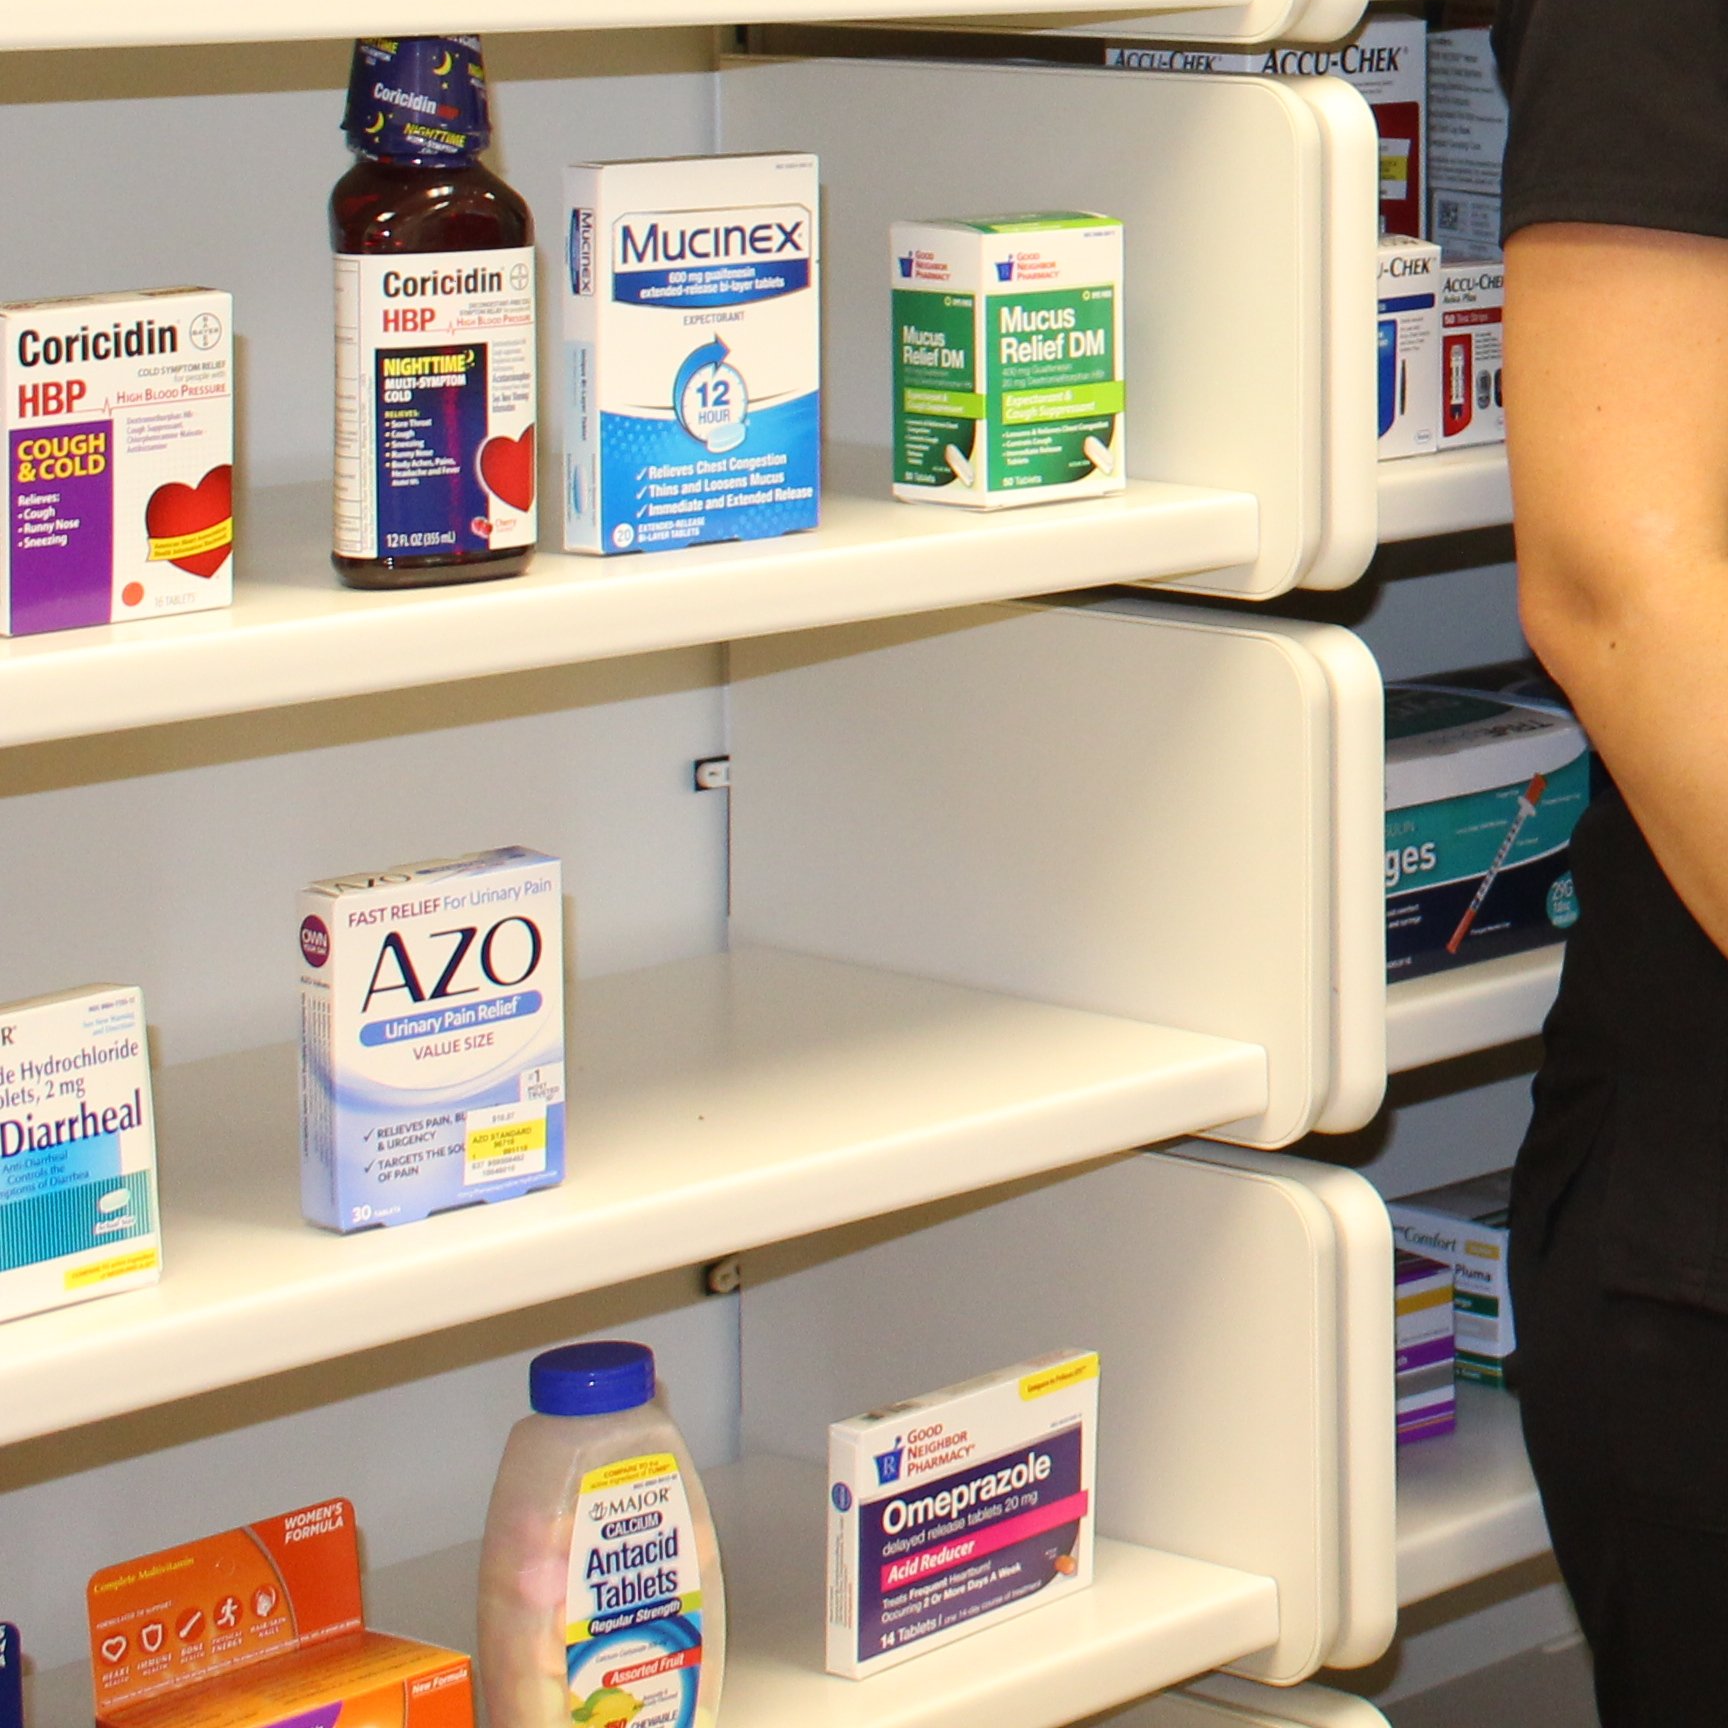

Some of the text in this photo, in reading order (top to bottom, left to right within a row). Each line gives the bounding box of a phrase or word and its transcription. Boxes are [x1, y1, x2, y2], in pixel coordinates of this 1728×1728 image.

[1114, 49, 1217, 72] ACCU-CHEK
[1262, 43, 1400, 75] ACCU-CHEK
[373, 82, 438, 115] Coricidin
[403, 122, 468, 148] NIGHTTIME
[383, 270, 502, 298] Coricidin
[382, 308, 435, 333] HBP
[683, 311, 745, 326] EXPECTORANT
[1000, 305, 1076, 334] Mucus
[18, 319, 179, 368] Coricidin
[903, 325, 945, 347] Mucus
[1000, 328, 1105, 365] Relief DM
[384, 355, 465, 378] NIGHTTIME
[903, 347, 965, 369] Relief DM
[116, 382, 227, 404] HIGH BLOOD PRESSURE
[384, 374, 467, 390] MULTI-SYMPTOM
[384, 389, 412, 403] COLD
[696, 379, 731, 409] 12
[18, 378, 87, 419] HBP
[698, 408, 731, 424] HOUR
[17, 432, 106, 462] COUGH
[18, 454, 106, 483] & COLD
[348, 878, 552, 928] FAST RELIEF For Urinary Pain
[360, 915, 543, 1014] AZO
[385, 996, 519, 1040] Urinary Pain Relief
[20, 1038, 140, 1080] Hydrochloride
[413, 1032, 495, 1061] VALUE SIZE
[45, 1077, 86, 1101] 2 mg
[1, 1087, 142, 1158] Diarrheal
[1455, 1263, 1492, 1283] Pluma
[907, 1423, 943, 1445] GOOD
[907, 1431, 968, 1460] NEIGHBOR
[907, 1443, 974, 1478] PHARMACY
[608, 1487, 671, 1517] MAJOR
[882, 1452, 1052, 1536] Omeprazole
[285, 1502, 343, 1530] WOMEN'S
[285, 1516, 344, 1544] FORMULA
[605, 1512, 660, 1539] CALCIUM
[587, 1526, 679, 1580] Antacid
[887, 1539, 975, 1584] Acid Reducer
[590, 1567, 679, 1612] Tablets
[591, 1599, 681, 1635] Regular Strength
[412, 1668, 468, 1694] New Formula
[610, 1652, 685, 1686] Assorted Fruit
